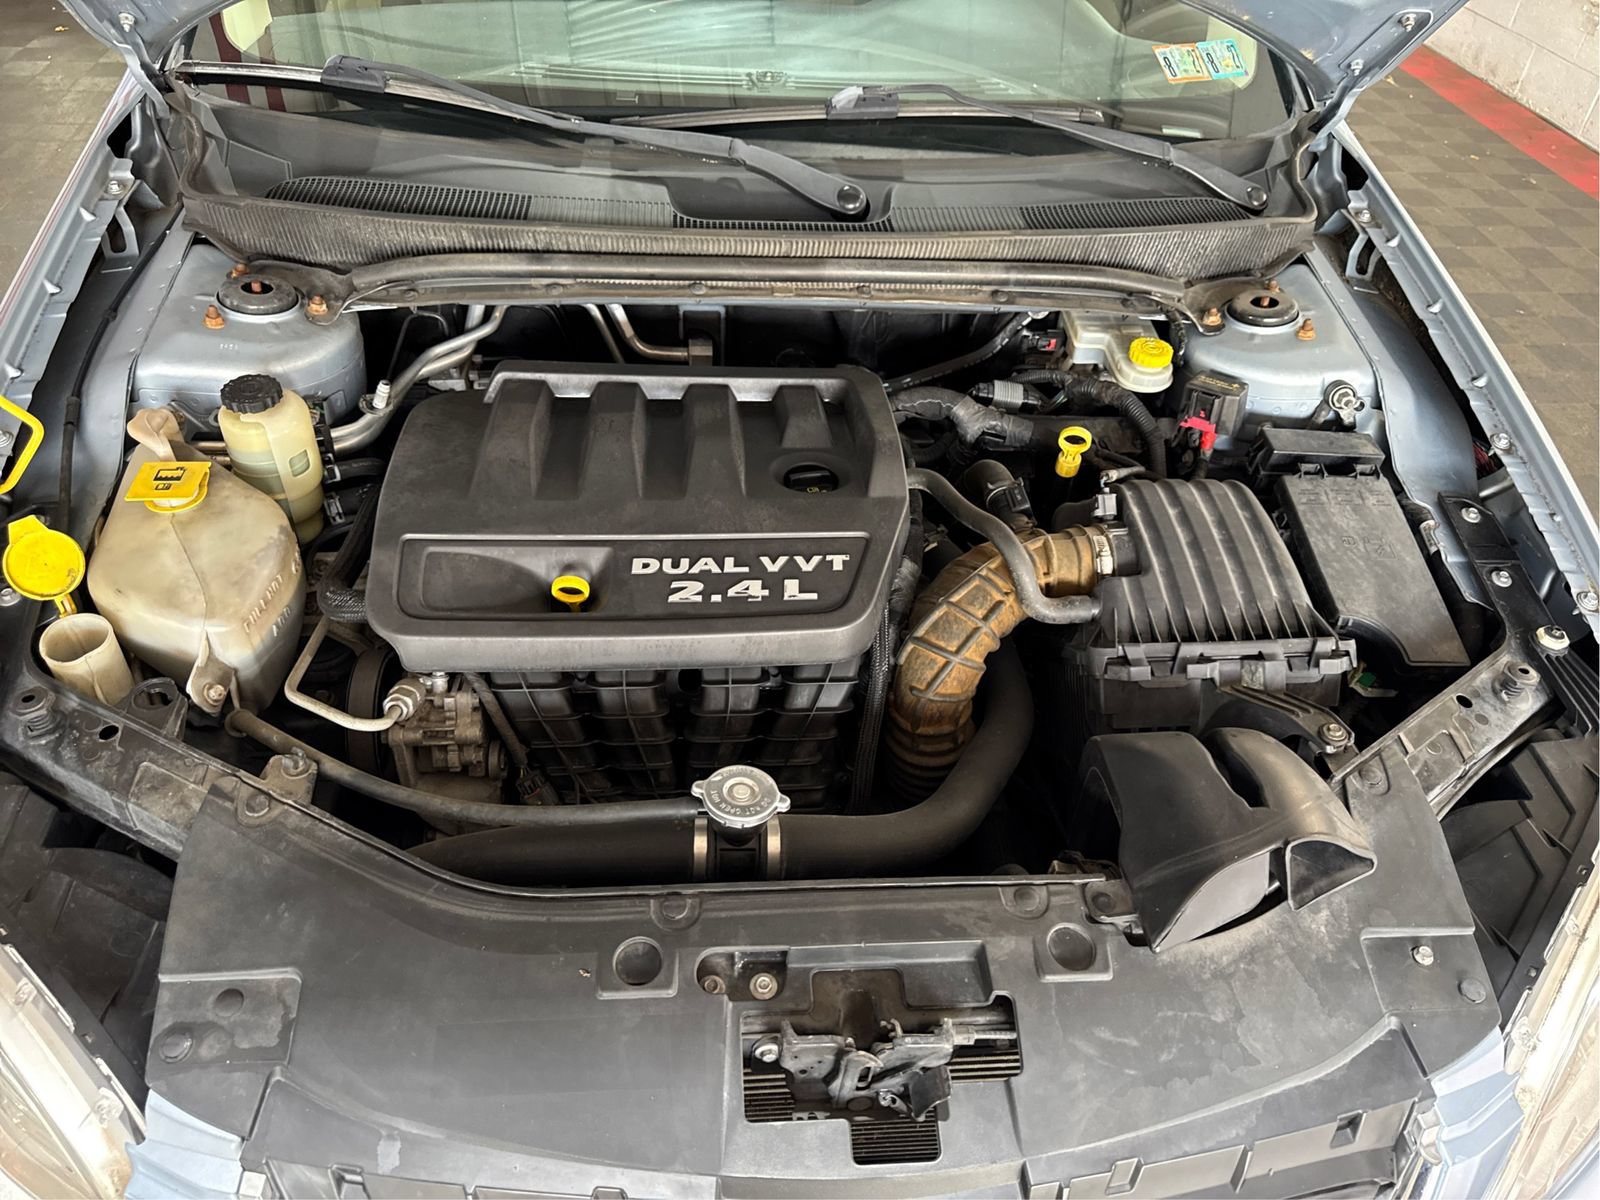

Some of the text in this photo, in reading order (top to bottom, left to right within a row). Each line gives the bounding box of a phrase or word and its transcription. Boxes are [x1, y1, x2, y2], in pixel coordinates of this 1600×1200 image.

[1163, 56, 1177, 77] 8
[1206, 52, 1220, 73] 8
[631, 554, 850, 575] DUAL VVT
[667, 578, 818, 602] 2.4 L
